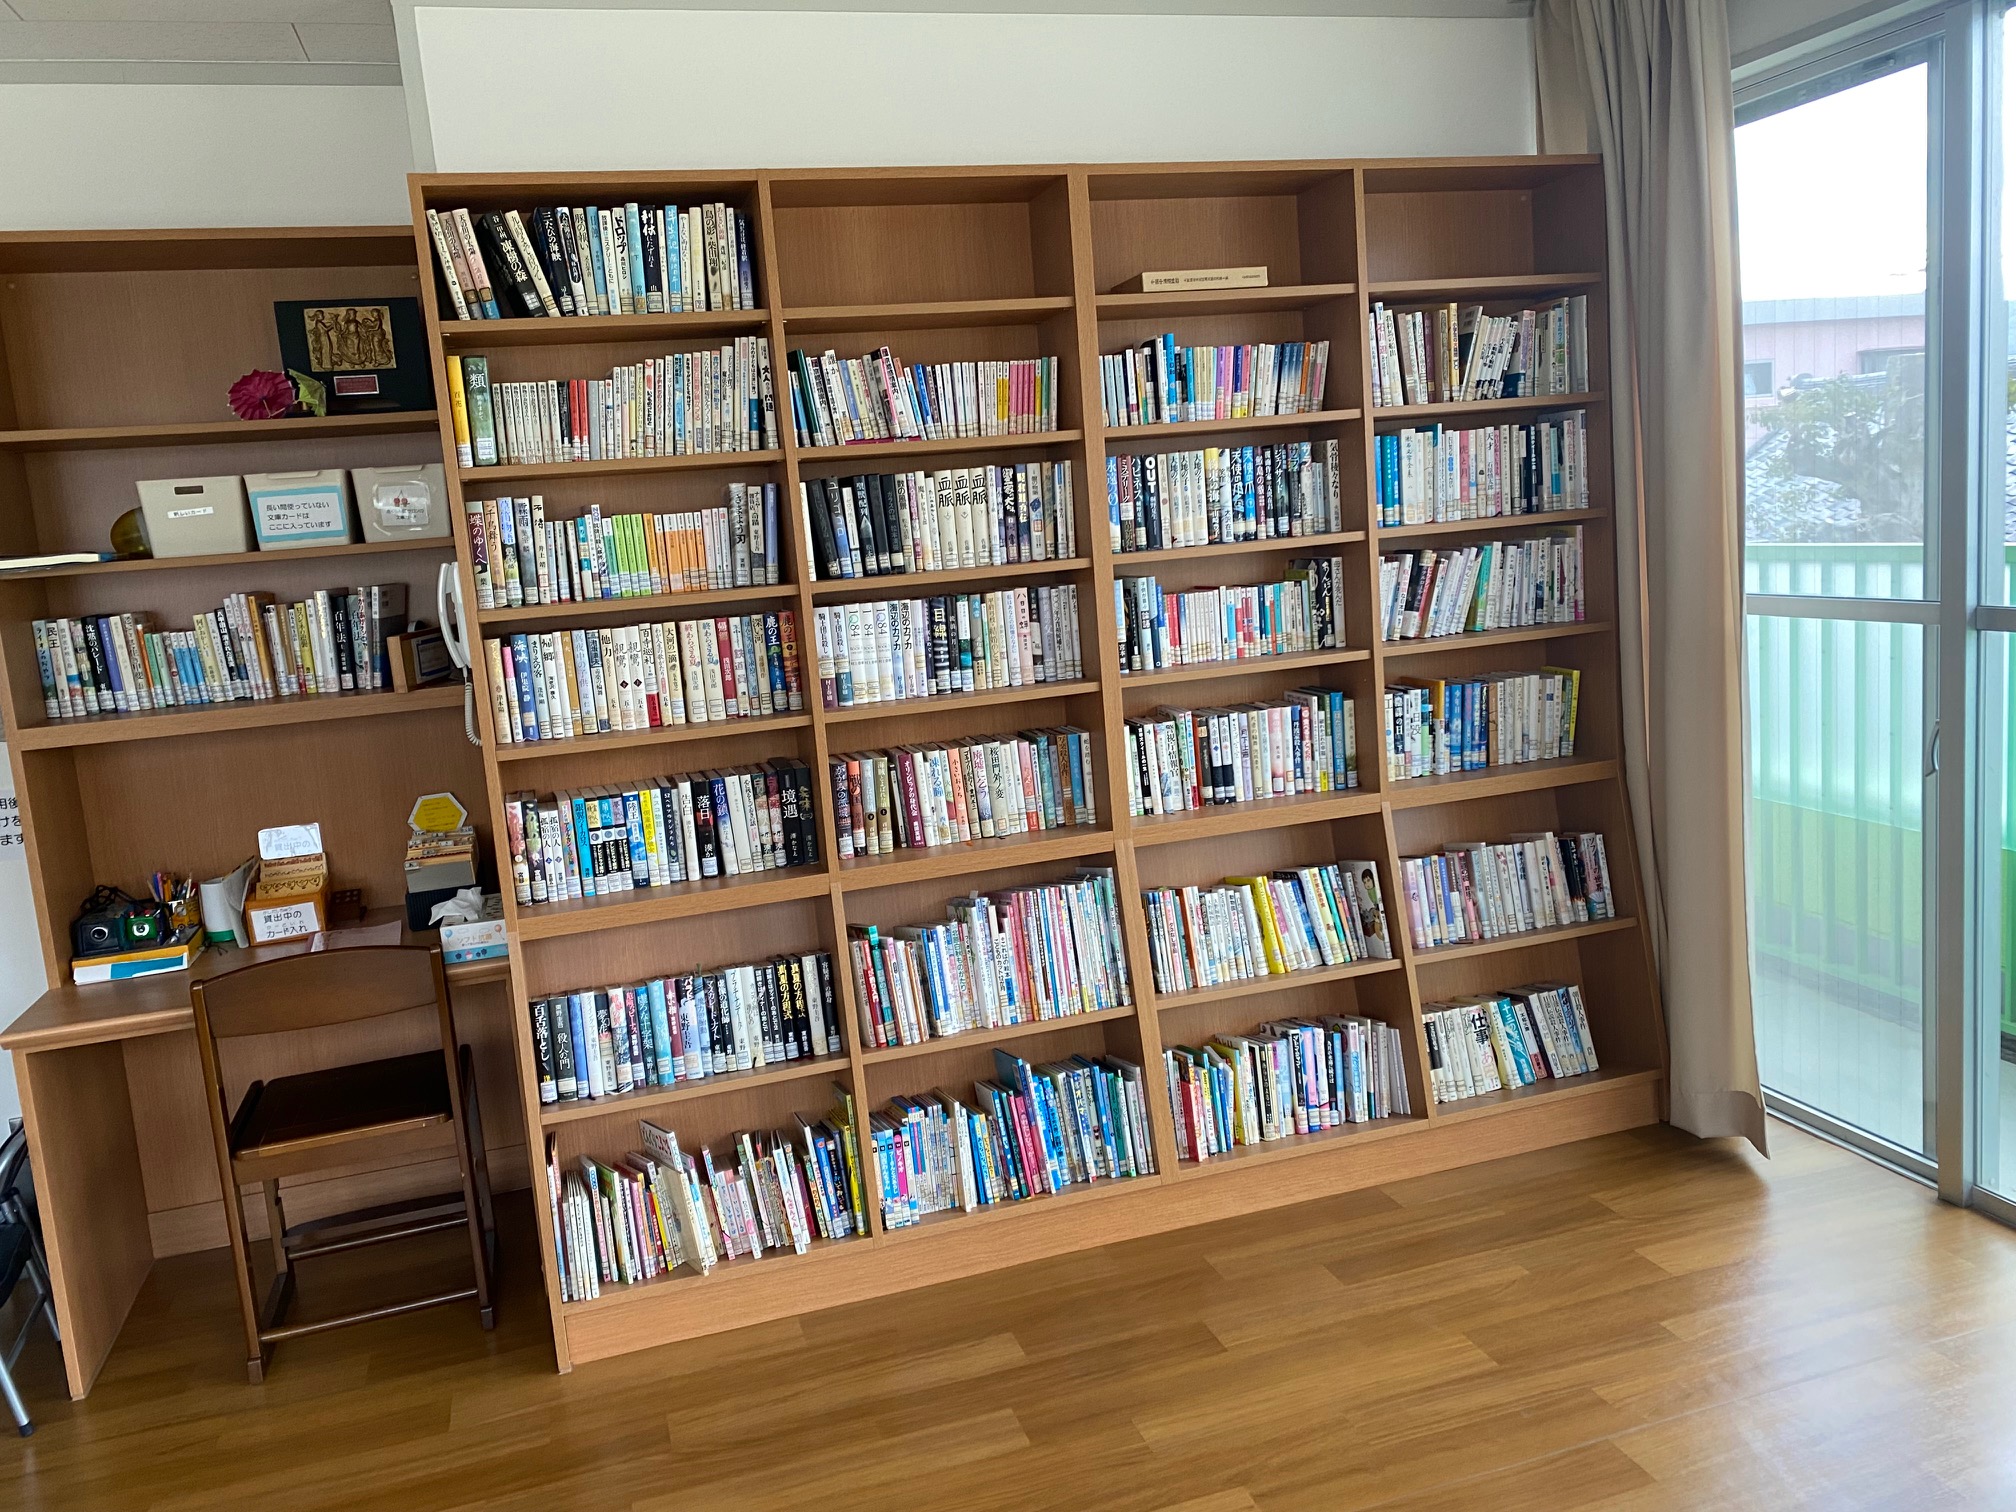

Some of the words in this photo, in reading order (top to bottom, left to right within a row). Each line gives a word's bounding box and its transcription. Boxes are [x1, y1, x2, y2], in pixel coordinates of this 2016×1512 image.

[542, 211, 562, 261] 三たびの海峡
[615, 215, 627, 254] ドロップ
[641, 210, 656, 268] 利休にたずねよ
[470, 373, 486, 388] 類
[1487, 433, 1494, 451] 天才
[1131, 458, 1142, 500] ハピネス
[1145, 456, 1157, 494] OUT
[1274, 450, 1283, 493] ジェノサイド
[266, 501, 330, 511] 長い間使っていない
[938, 477, 954, 508] 血脈
[955, 475, 971, 507] 血脈
[972, 474, 988, 505] 血脈
[267, 512, 310, 521] 文庫カードは
[269, 520, 331, 530] ここに入っています
[736, 494, 746, 545] さまよう刃
[469, 514, 487, 564] 蝶のゆくへ
[47, 627, 59, 648] 民王
[335, 610, 347, 643] 百年法
[752, 618, 763, 644] 深い河
[766, 616, 780, 646] 鹿の王
[781, 615, 794, 644] 鹿の王
[818, 613, 828, 654] 騎士団長殺し
[889, 603, 900, 651] 海辺のカフカ
[901, 602, 912, 650] 海辺のカフカ
[36, 627, 50, 680] ライオンのおやつ
[86, 624, 103, 675] 沈黙のパレード
[514, 640, 528, 664] 海峡
[601, 635, 612, 657] 他力
[641, 629, 654, 664] 百寺巡礼
[666, 628, 678, 664] 大河の一滴
[904, 760, 918, 816] オリンピックの身代金
[952, 759, 963, 798] 小さいおうち
[990, 747, 1004, 799] 桜田門外ノ変
[626, 802, 638, 820] 陸王
[697, 795, 711, 819] 落日
[713, 784, 729, 816] 花の鎖
[781, 789, 799, 818] 境遇
[540, 817, 551, 848] 孤宿の人
[550, 816, 561, 847] 孤宿の人
[575, 803, 588, 846] 銀翼のイカロス
[790, 833, 798, 857] 湊かなえ
[264, 910, 302, 923] 貸出中の
[266, 925, 307, 939] カード入れ
[777, 964, 793, 1020] 真夏の方程式
[791, 963, 806, 1018] 真夏の方程式
[533, 1003, 550, 1061] 百舌落とし
[638, 994, 653, 1049] 虚ろな十字架
[1471, 1014, 1488, 1044] 仕事
[557, 1033, 571, 1070] 殺人の門
